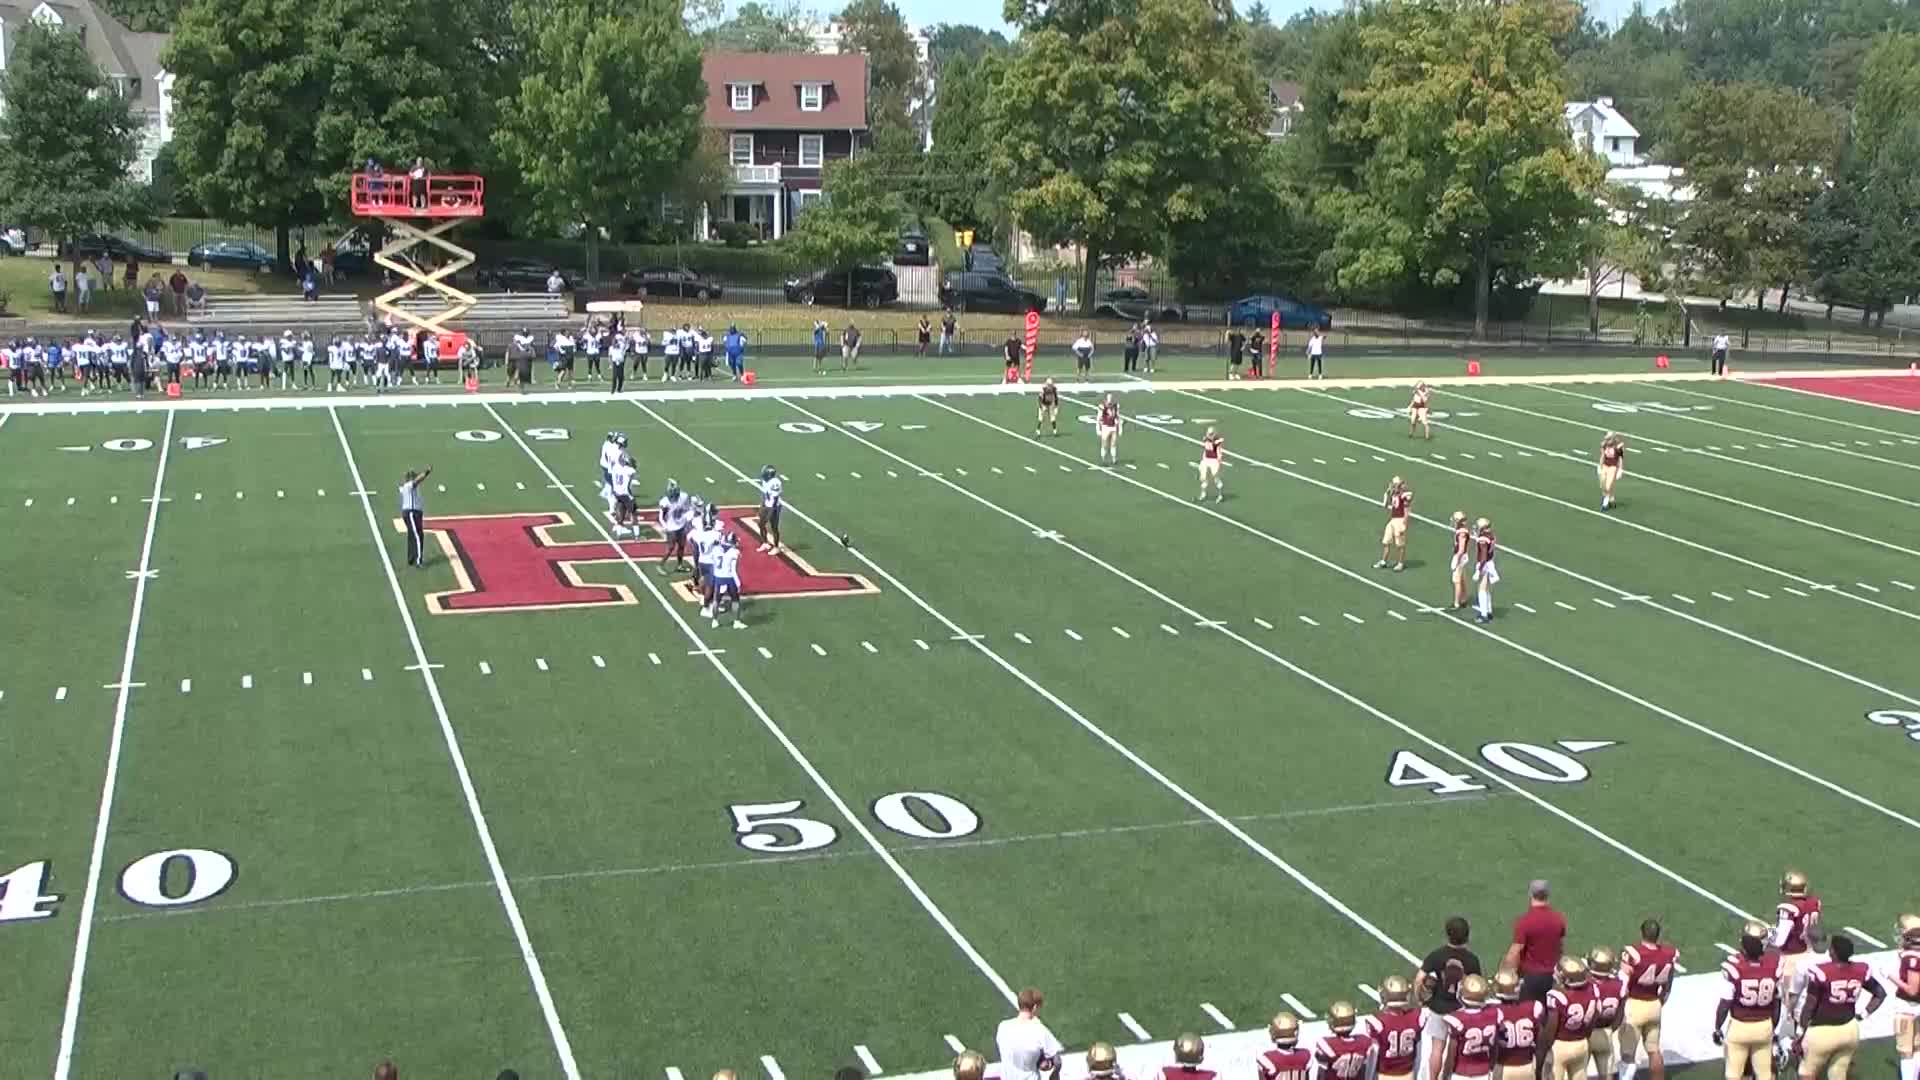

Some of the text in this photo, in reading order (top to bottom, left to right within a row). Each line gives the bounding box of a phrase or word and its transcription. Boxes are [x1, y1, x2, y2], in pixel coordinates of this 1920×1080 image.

[1384, 739, 1592, 797] 40
[728, 790, 984, 853] 50
[1637, 962, 1673, 985] 44
[1738, 977, 1777, 1007] 58
